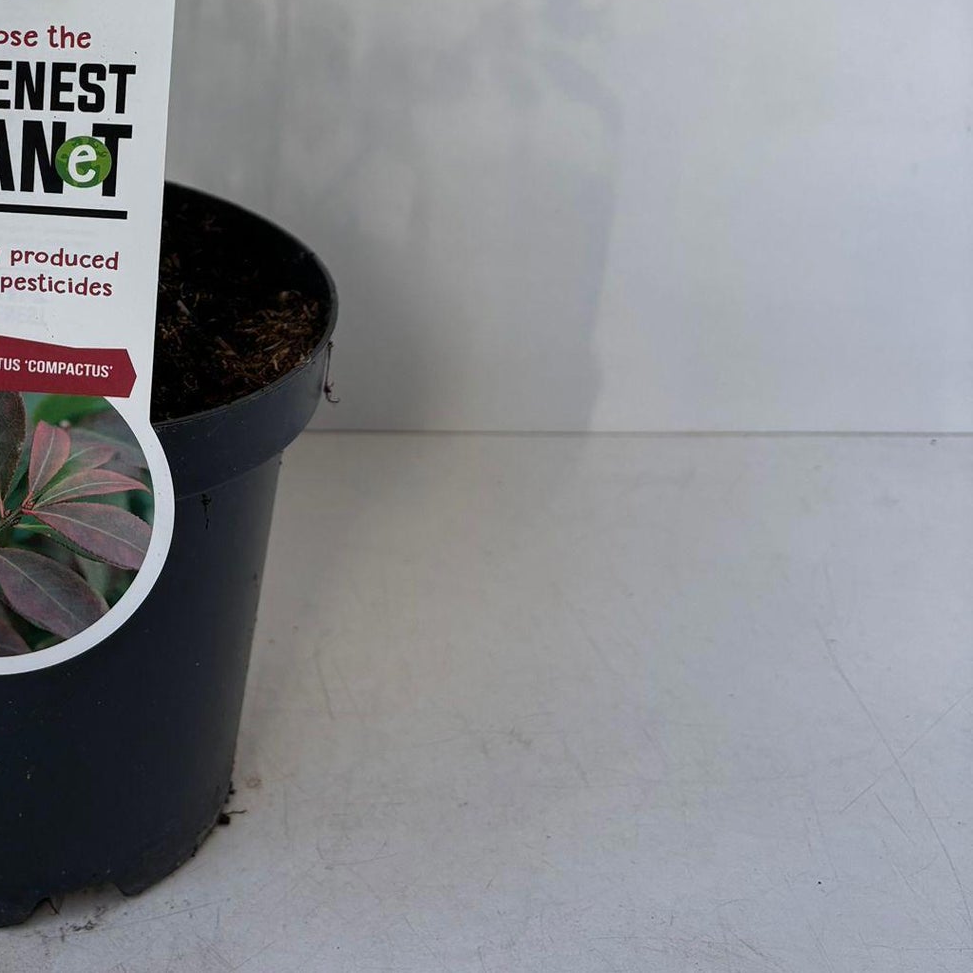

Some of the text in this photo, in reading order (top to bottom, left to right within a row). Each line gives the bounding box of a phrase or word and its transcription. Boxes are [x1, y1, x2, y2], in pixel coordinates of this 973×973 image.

[47, 25, 92, 49] the
[10, 248, 119, 270] produced
[0, 272, 113, 297] pesticides
